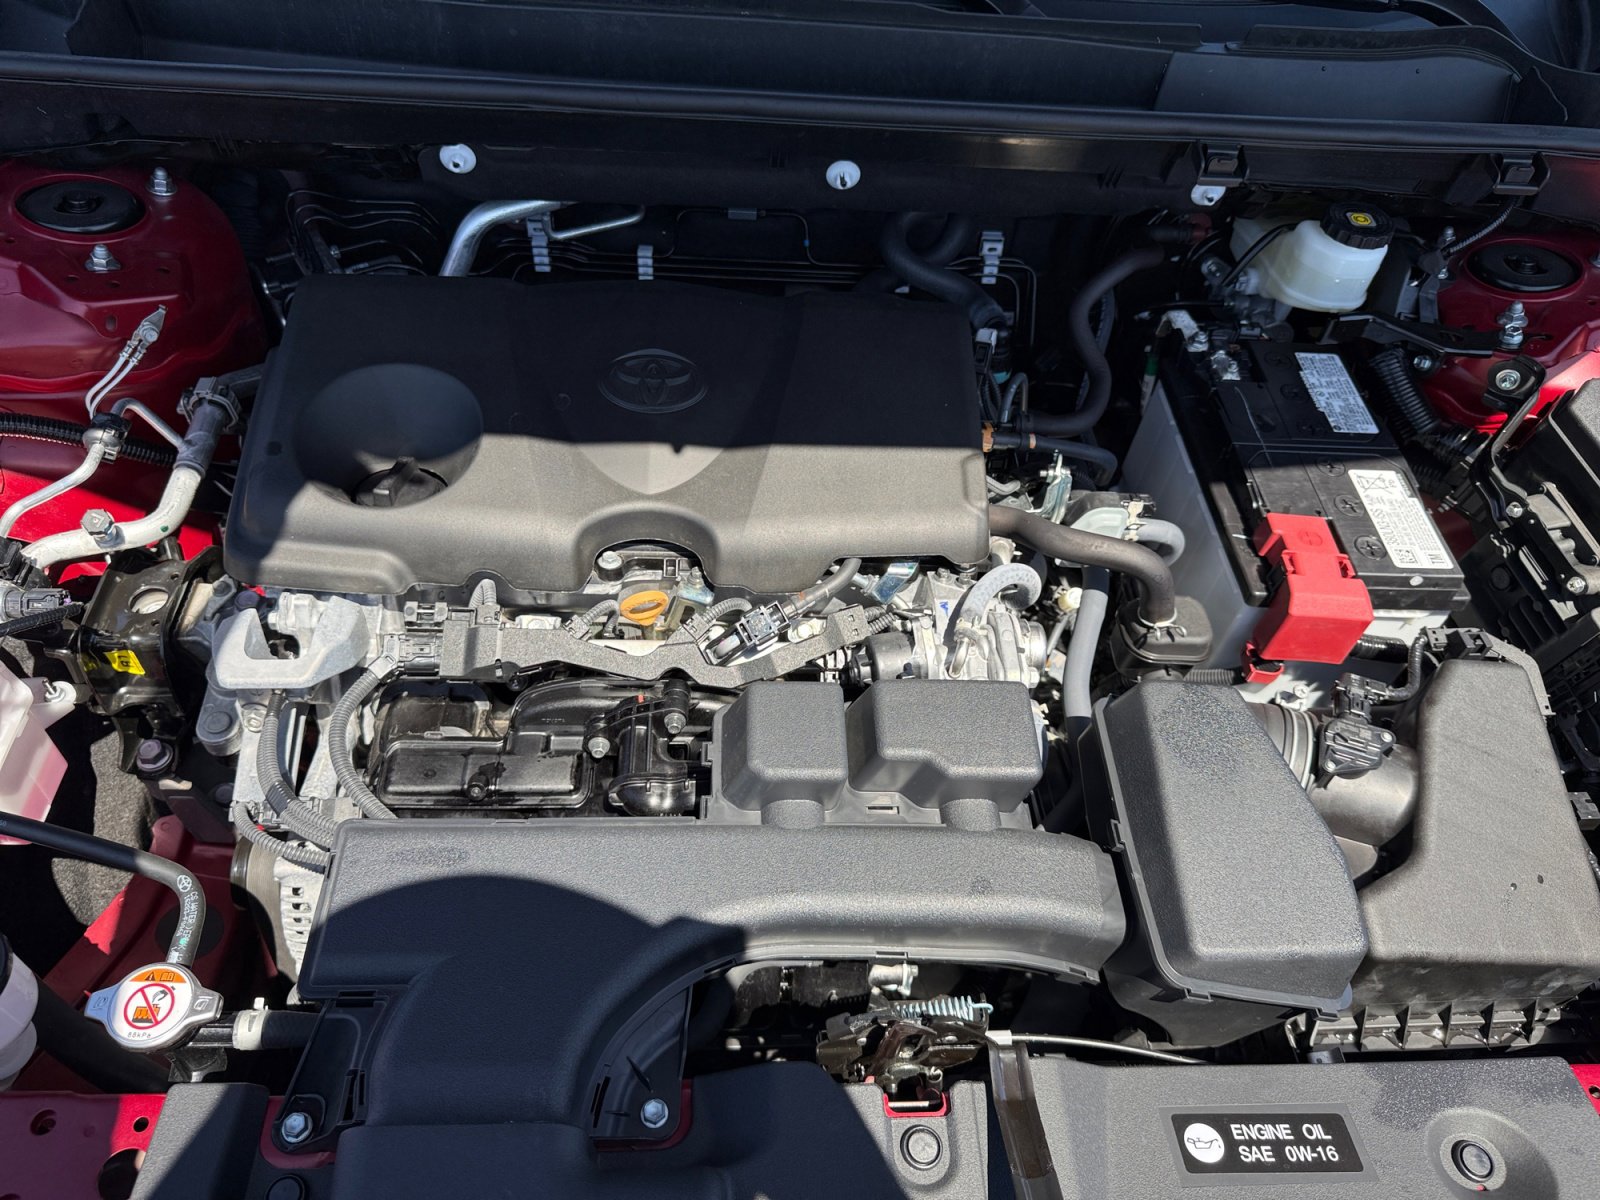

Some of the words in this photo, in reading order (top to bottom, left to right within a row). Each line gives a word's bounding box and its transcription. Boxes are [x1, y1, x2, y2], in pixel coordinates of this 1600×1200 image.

[1230, 1123, 1294, 1140] ENGINE
[1302, 1123, 1332, 1140] OIL
[1238, 1145, 1275, 1162] SAE
[1285, 1145, 1339, 1163] 0W-16
